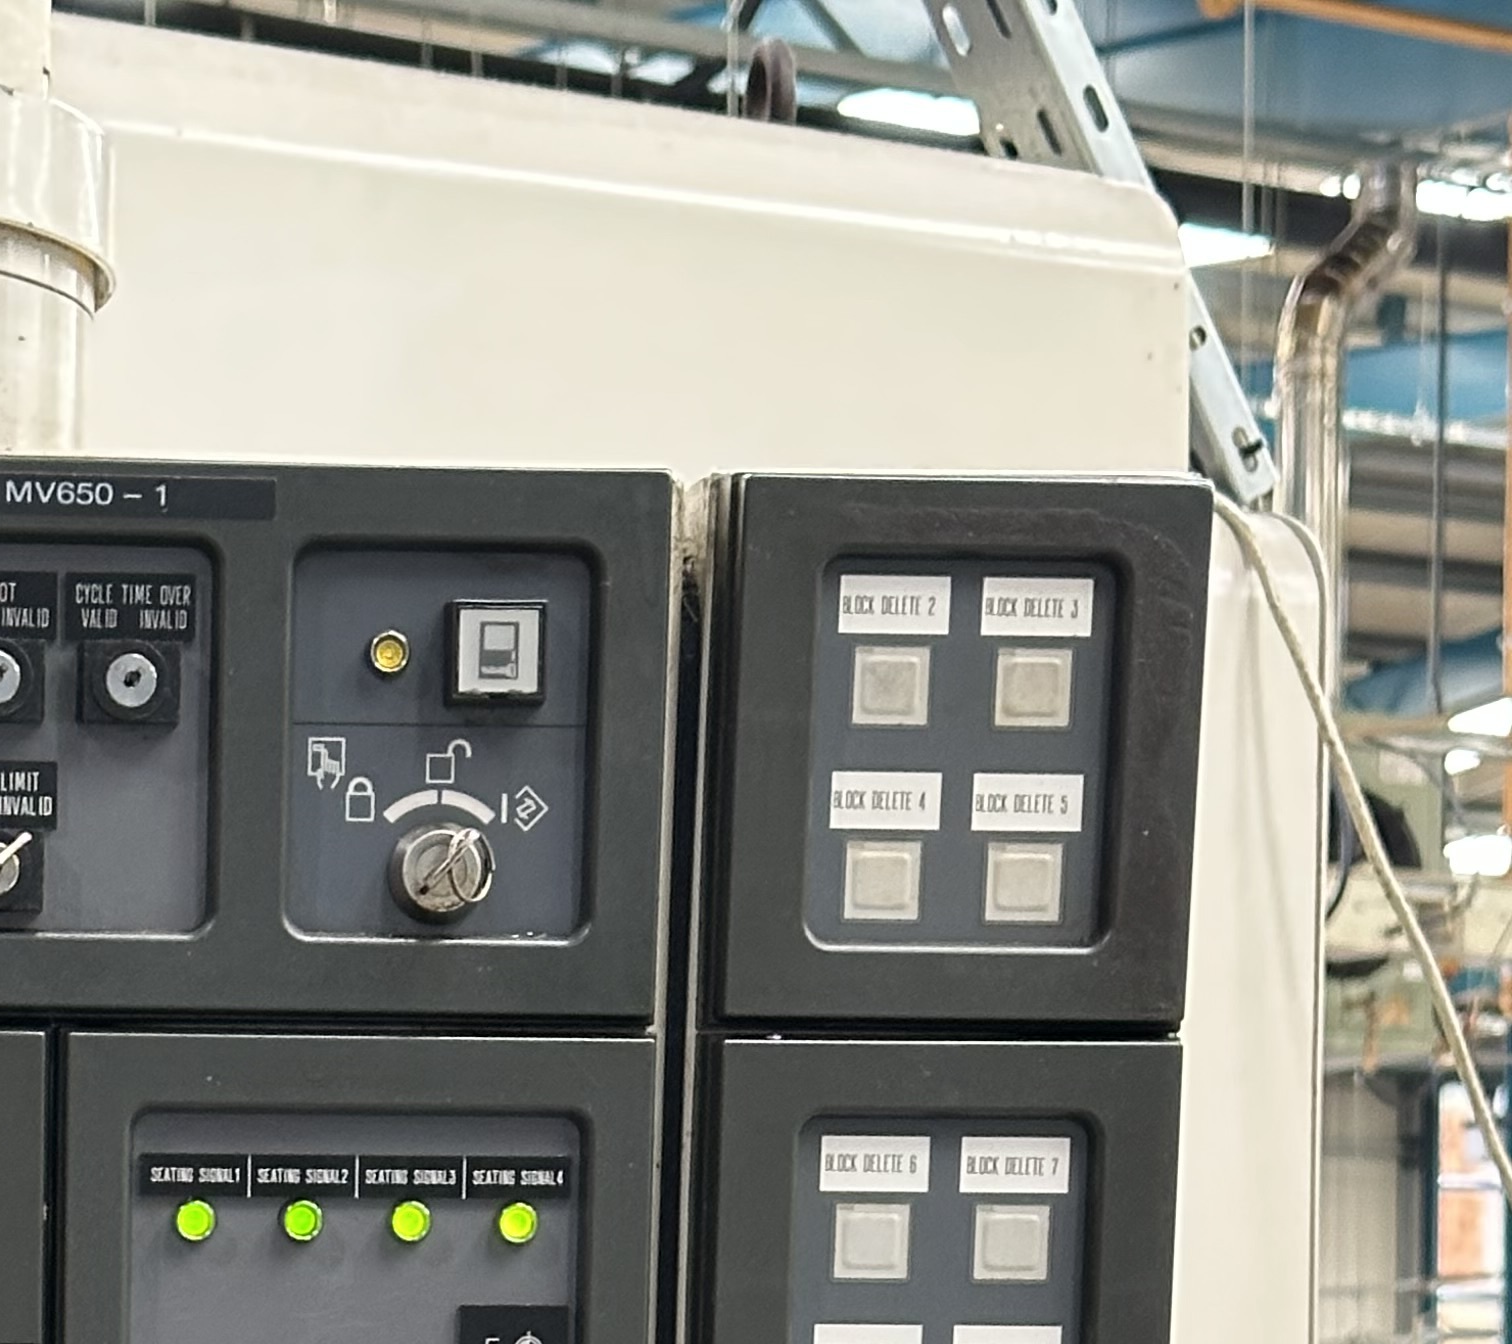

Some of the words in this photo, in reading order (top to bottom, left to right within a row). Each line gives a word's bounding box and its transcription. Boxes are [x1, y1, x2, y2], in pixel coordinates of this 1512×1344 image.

[5, 480, 112, 504] MV650
[155, 484, 167, 505] 1
[76, 583, 113, 604] CYCLE
[122, 585, 154, 606] TIME
[160, 585, 190, 606] OVER
[843, 596, 875, 615] BLOCK
[881, 596, 922, 615] DELETE
[928, 598, 936, 616] 2
[1, 607, 49, 627] INVALID
[81, 608, 117, 629] VALID
[139, 609, 187, 631] INVALID
[1, 772, 39, 791] LIMIT
[834, 791, 866, 809] BLOCK
[872, 791, 912, 810] DELETE
[919, 792, 926, 810] 4
[825, 1154, 857, 1173] BLOCK
[863, 1154, 903, 1173] DELETE
[909, 1155, 916, 1174] 6
[967, 1156, 999, 1175] BLOCK
[1005, 1157, 1045, 1176] DELETE
[1051, 1158, 1059, 1176] 7
